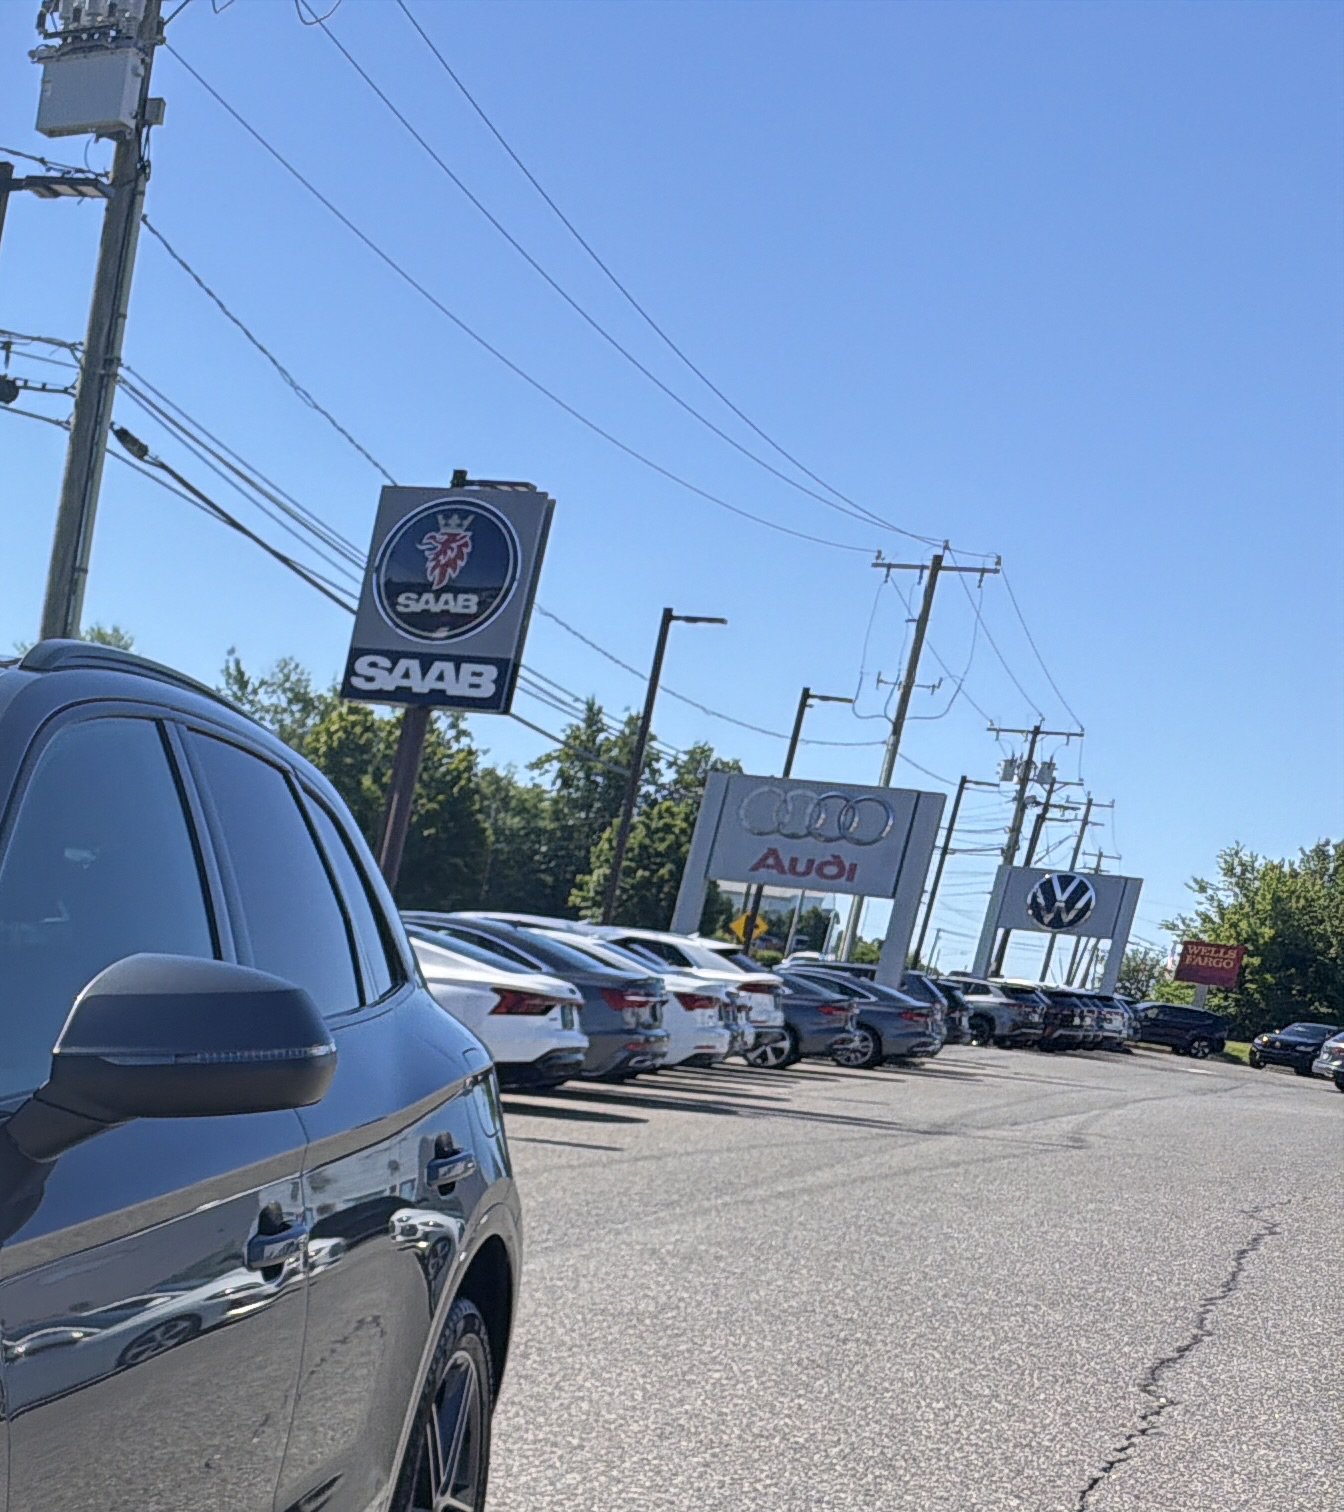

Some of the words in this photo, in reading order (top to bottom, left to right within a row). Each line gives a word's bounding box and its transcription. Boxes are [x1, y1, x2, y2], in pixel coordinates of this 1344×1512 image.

[395, 592, 480, 615] SAAB
[350, 654, 499, 698] SAAB
[749, 847, 858, 882] Audi
[1184, 954, 1234, 969] FARGO
[1186, 944, 1238, 959] WELLS
